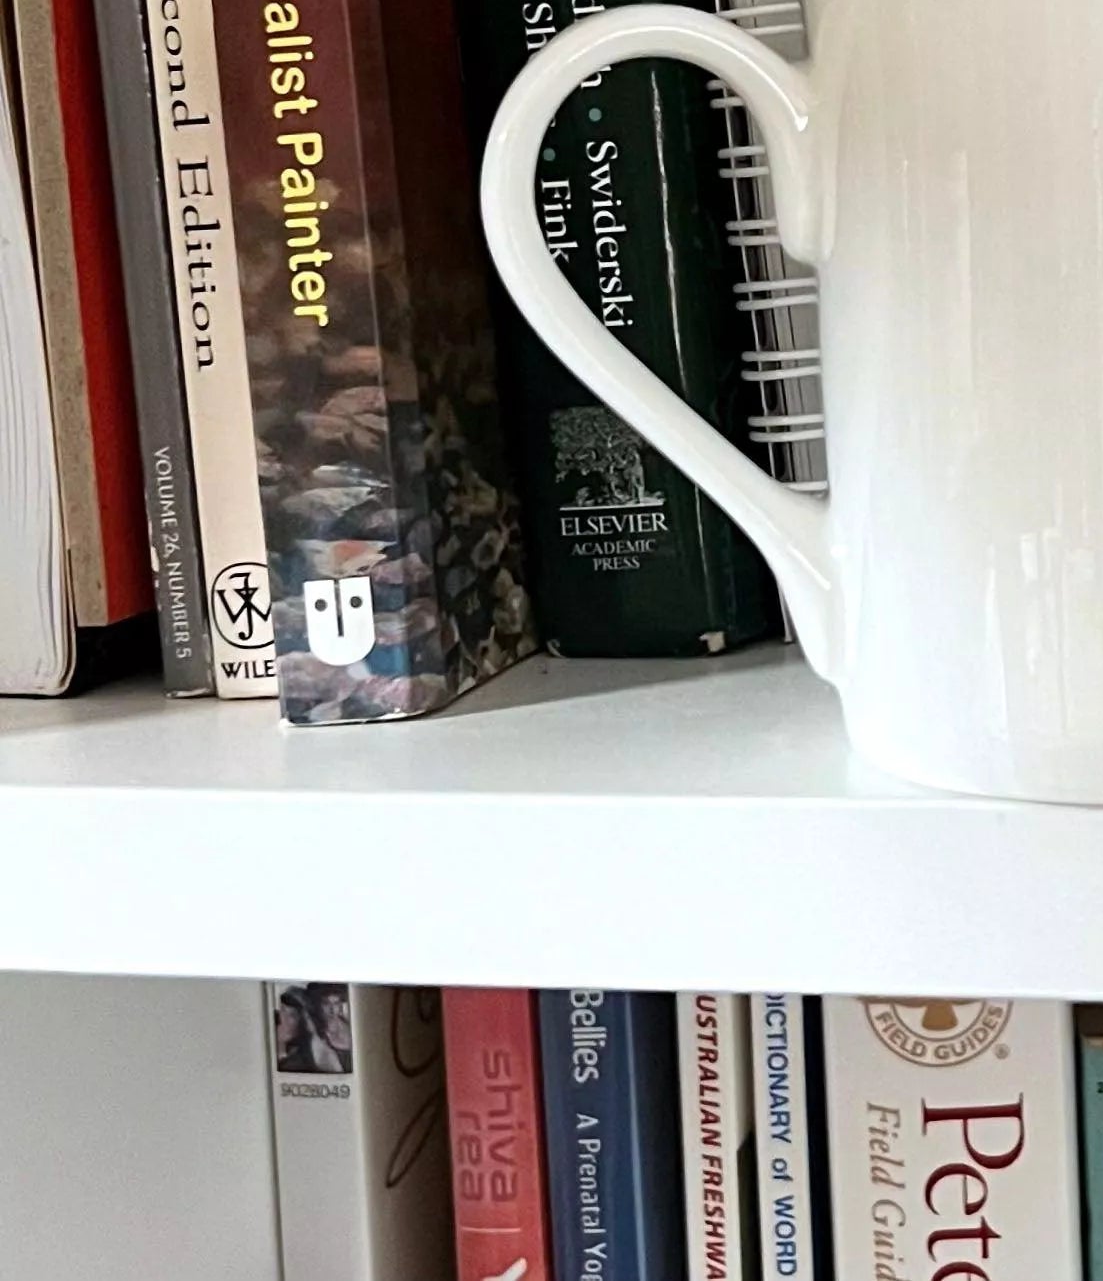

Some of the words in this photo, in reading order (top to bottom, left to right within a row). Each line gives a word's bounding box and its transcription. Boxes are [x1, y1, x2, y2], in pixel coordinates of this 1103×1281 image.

[276, 130, 332, 327] Painter
[540, 177, 580, 265] Fink
[586, 139, 635, 329] Swiderski
[176, 157, 222, 372] Edition
[153, 446, 178, 529] VOLUME
[559, 512, 669, 537] ELSEVIER
[571, 539, 657, 557] ACADEMIC
[592, 556, 641, 571] PRESS
[165, 561, 191, 646] NUMBER
[175, 647, 192, 659] 5
[220, 659, 276, 680] WILE
[570, 989, 608, 1084] Bellies
[694, 994, 724, 1148] USTRALIAN
[876, 1011, 928, 1059] FIELD
[932, 1005, 1005, 1060] GUIDES
[455, 1110, 486, 1202] rea
[481, 1047, 524, 1205] shiva
[575, 1112, 600, 1130] A
[866, 1101, 907, 1190] Field
[577, 1138, 607, 1234] Prenatal
[771, 1157, 795, 1183] of
[701, 1153, 728, 1281] FRESHWA
[772, 1194, 799, 1277] WORD
[871, 1198, 911, 1281] Guid
